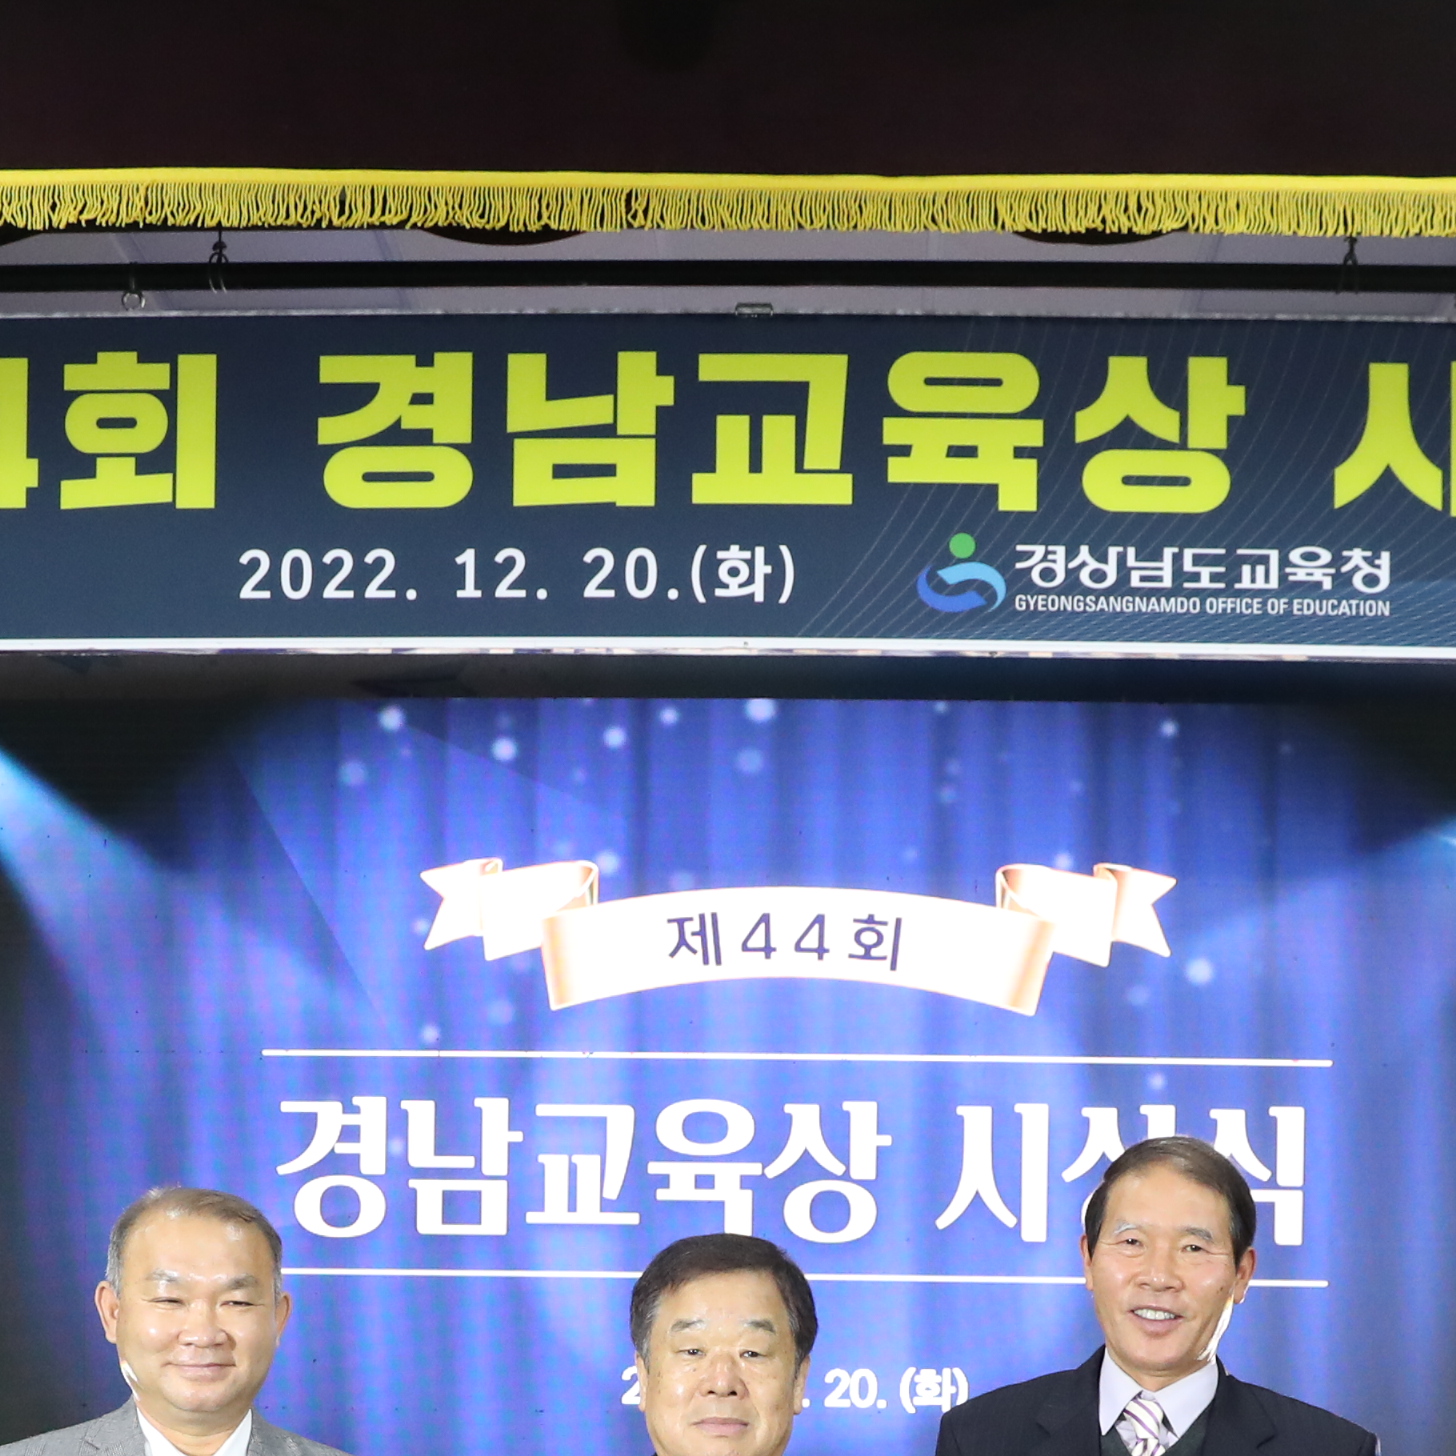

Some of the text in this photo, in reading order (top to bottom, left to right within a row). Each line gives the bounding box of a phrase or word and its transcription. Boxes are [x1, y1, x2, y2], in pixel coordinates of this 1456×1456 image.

[317, 350, 1246, 515] 경남교육상
[239, 544, 796, 605] 2022. 12. 20.(화)
[1014, 543, 1392, 594] 경상남도교육청
[1014, 594, 1391, 617] GYEONGSANGNAMDO OFFICE OF EDUCATION
[666, 912, 901, 972] 제44회
[275, 1096, 893, 1244] 경남교육상
[824, 1368, 887, 1409] 20.
